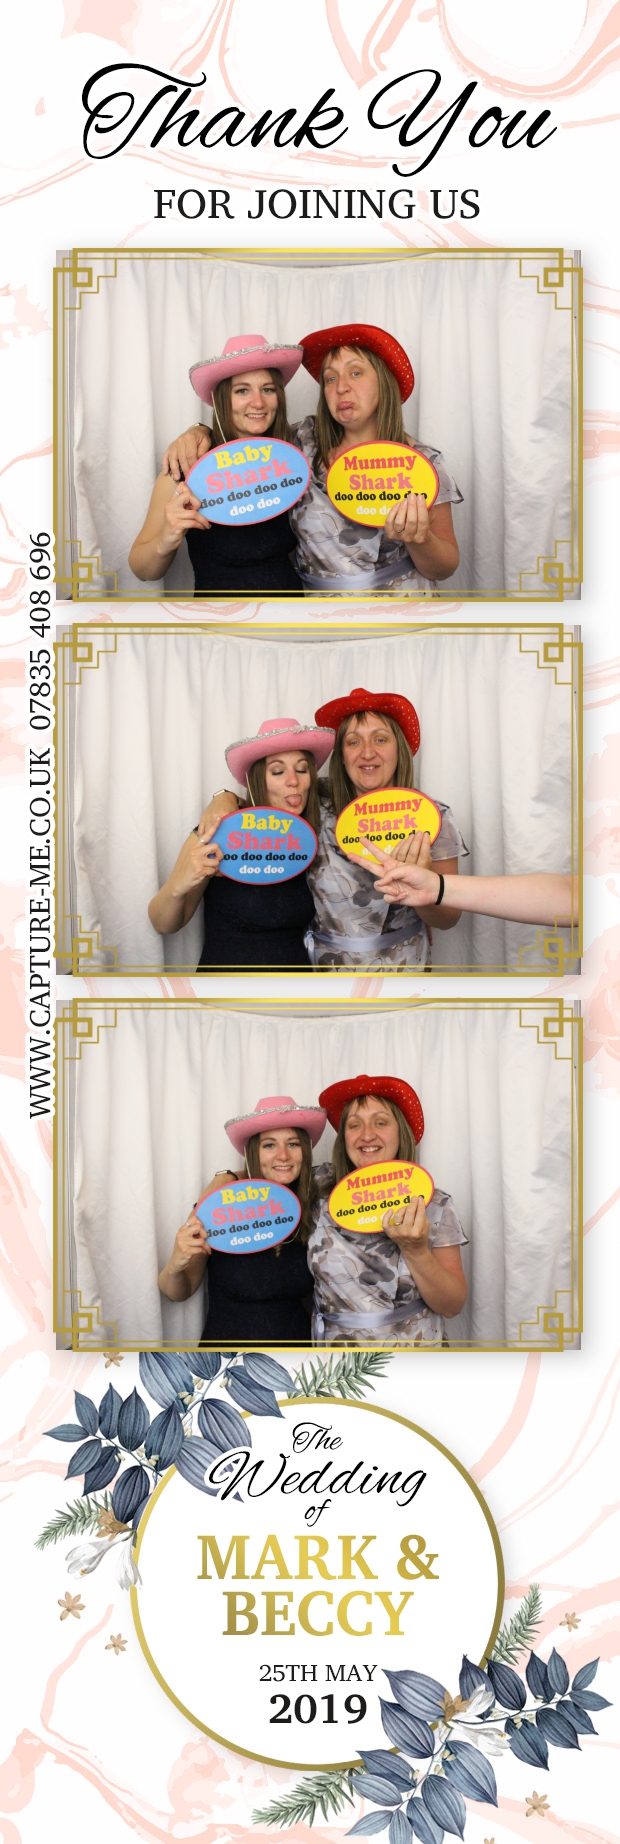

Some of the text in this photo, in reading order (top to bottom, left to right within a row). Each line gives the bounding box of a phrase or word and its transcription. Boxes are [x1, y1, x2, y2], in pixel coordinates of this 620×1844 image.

[214, 444, 273, 469] Baby
[343, 455, 418, 471] Mummy
[205, 458, 293, 494] Shark
[349, 472, 413, 491] Shark
[200, 475, 303, 509] doo doo doo doo
[335, 492, 354, 501] doo
[356, 491, 376, 501] doo
[379, 491, 401, 501] doo
[229, 496, 281, 517] doo doo
[356, 505, 377, 515] doo
[354, 798, 424, 817] Mummy
[241, 813, 293, 834] Baby
[357, 814, 419, 834] Shark
[227, 831, 302, 851] Shark
[385, 831, 406, 841] doo
[222, 852, 308, 861] oo doo doo doo
[239, 865, 284, 874] doo doo
[346, 1166, 415, 1191] Mummy
[220, 1185, 271, 1205] Baby
[351, 1182, 412, 1206] Shark
[211, 1199, 286, 1226] Shark
[336, 1209, 355, 1218] doo
[358, 1204, 377, 1213] doo
[380, 1199, 401, 1209] doo
[206, 1215, 294, 1238] doo doo doo doo
[357, 1215, 378, 1226] doo
[230, 1231, 274, 1246] doo doo
